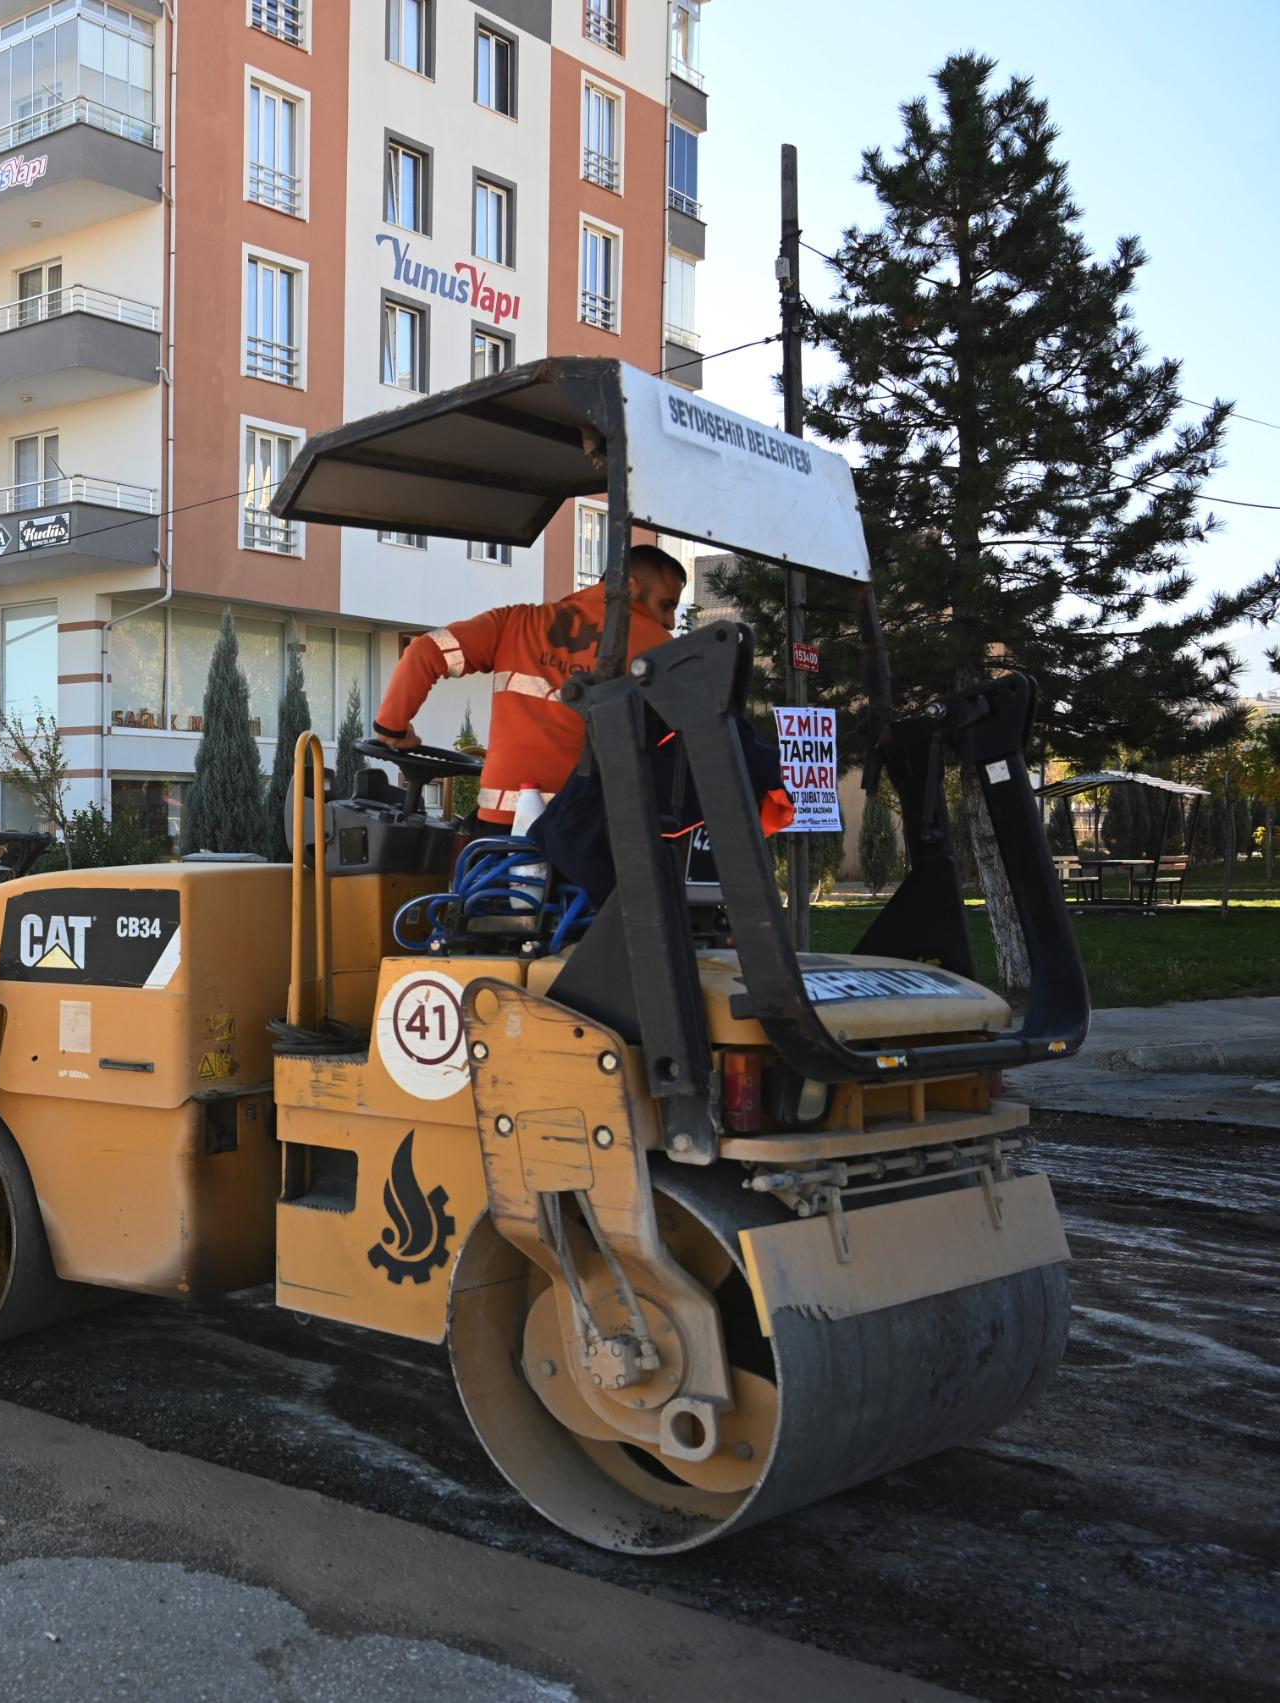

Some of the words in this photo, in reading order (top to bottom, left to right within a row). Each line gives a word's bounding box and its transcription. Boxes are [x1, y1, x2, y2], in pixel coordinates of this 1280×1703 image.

[22, 524, 66, 541] Kudüs
[775, 709, 833, 737] İZMİR
[780, 740, 833, 763] TARIM
[781, 766, 834, 789] FUARI
[801, 791, 820, 806] ŞUBAT
[20, 913, 92, 970] CAT
[116, 915, 162, 939] CB34
[404, 1003, 446, 1041] 41
